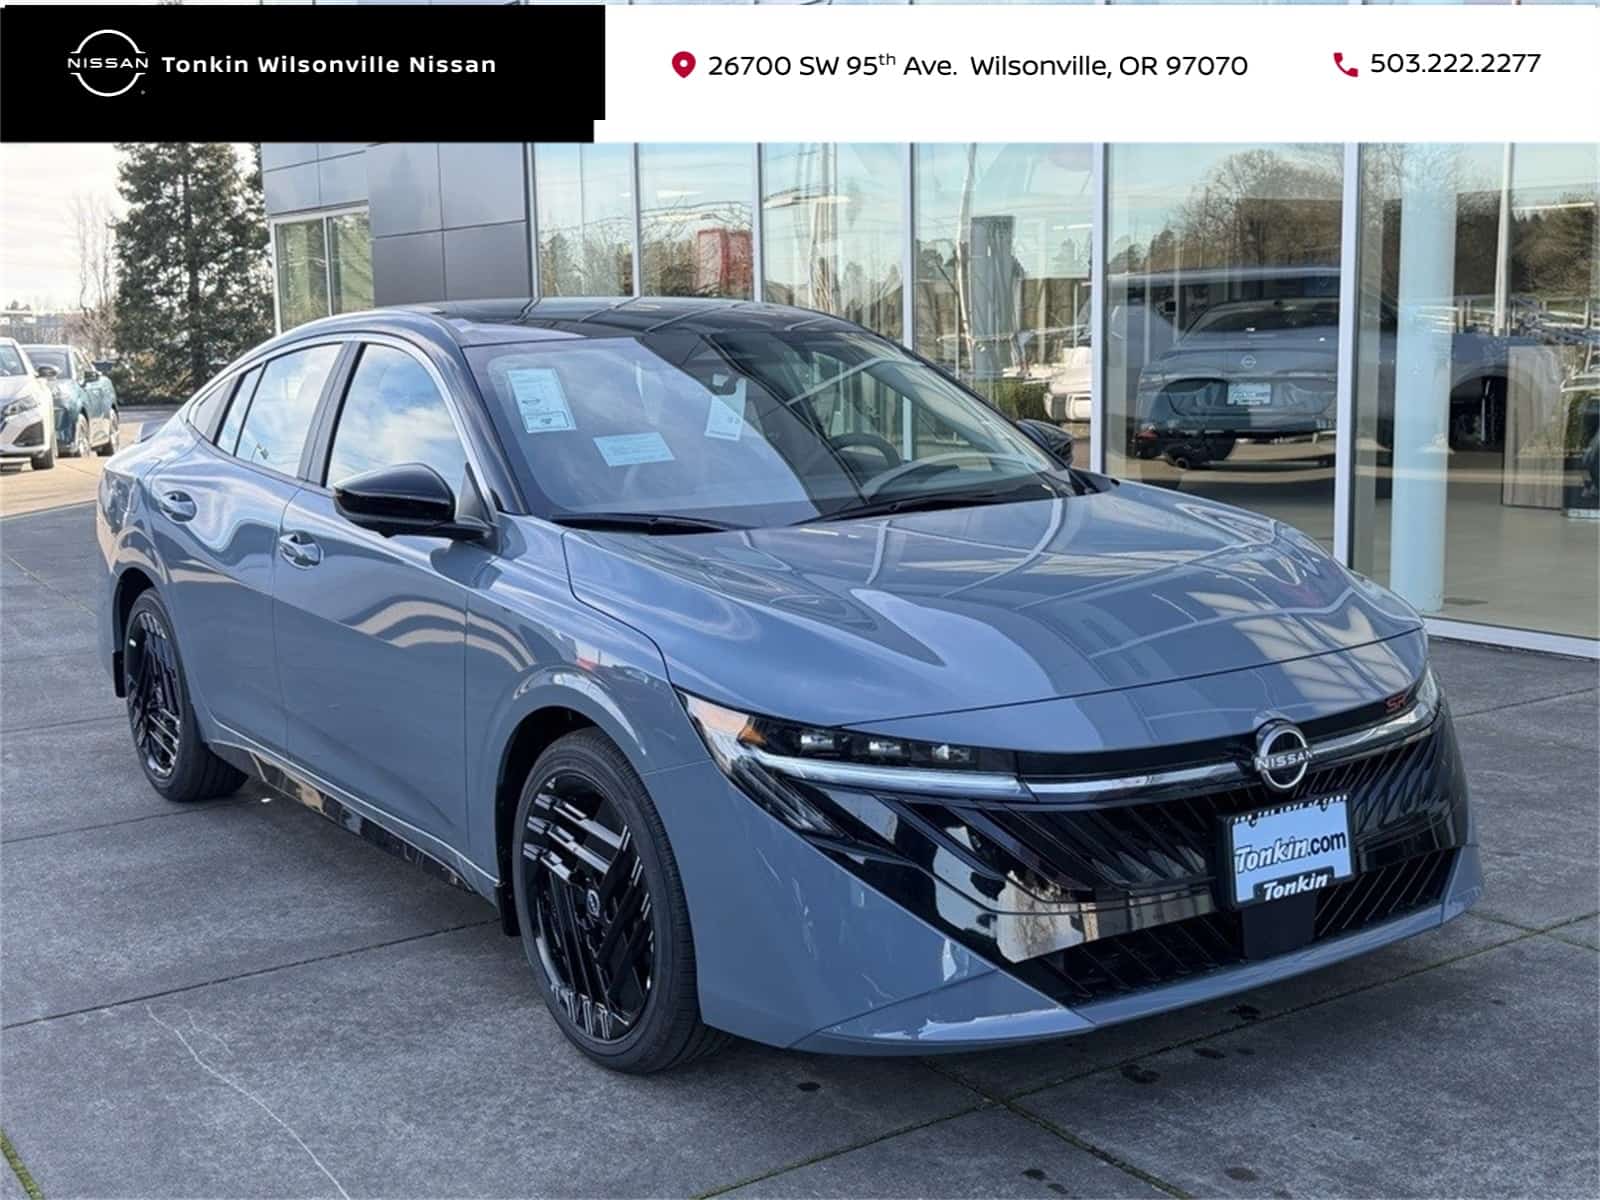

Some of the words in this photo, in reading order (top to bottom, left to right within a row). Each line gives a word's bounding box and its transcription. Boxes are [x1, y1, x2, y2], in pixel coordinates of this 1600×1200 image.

[1255, 750, 1312, 770] NISSAN
[1234, 832, 1347, 874] Tonkin.com
[1264, 873, 1328, 901] Tonkin
